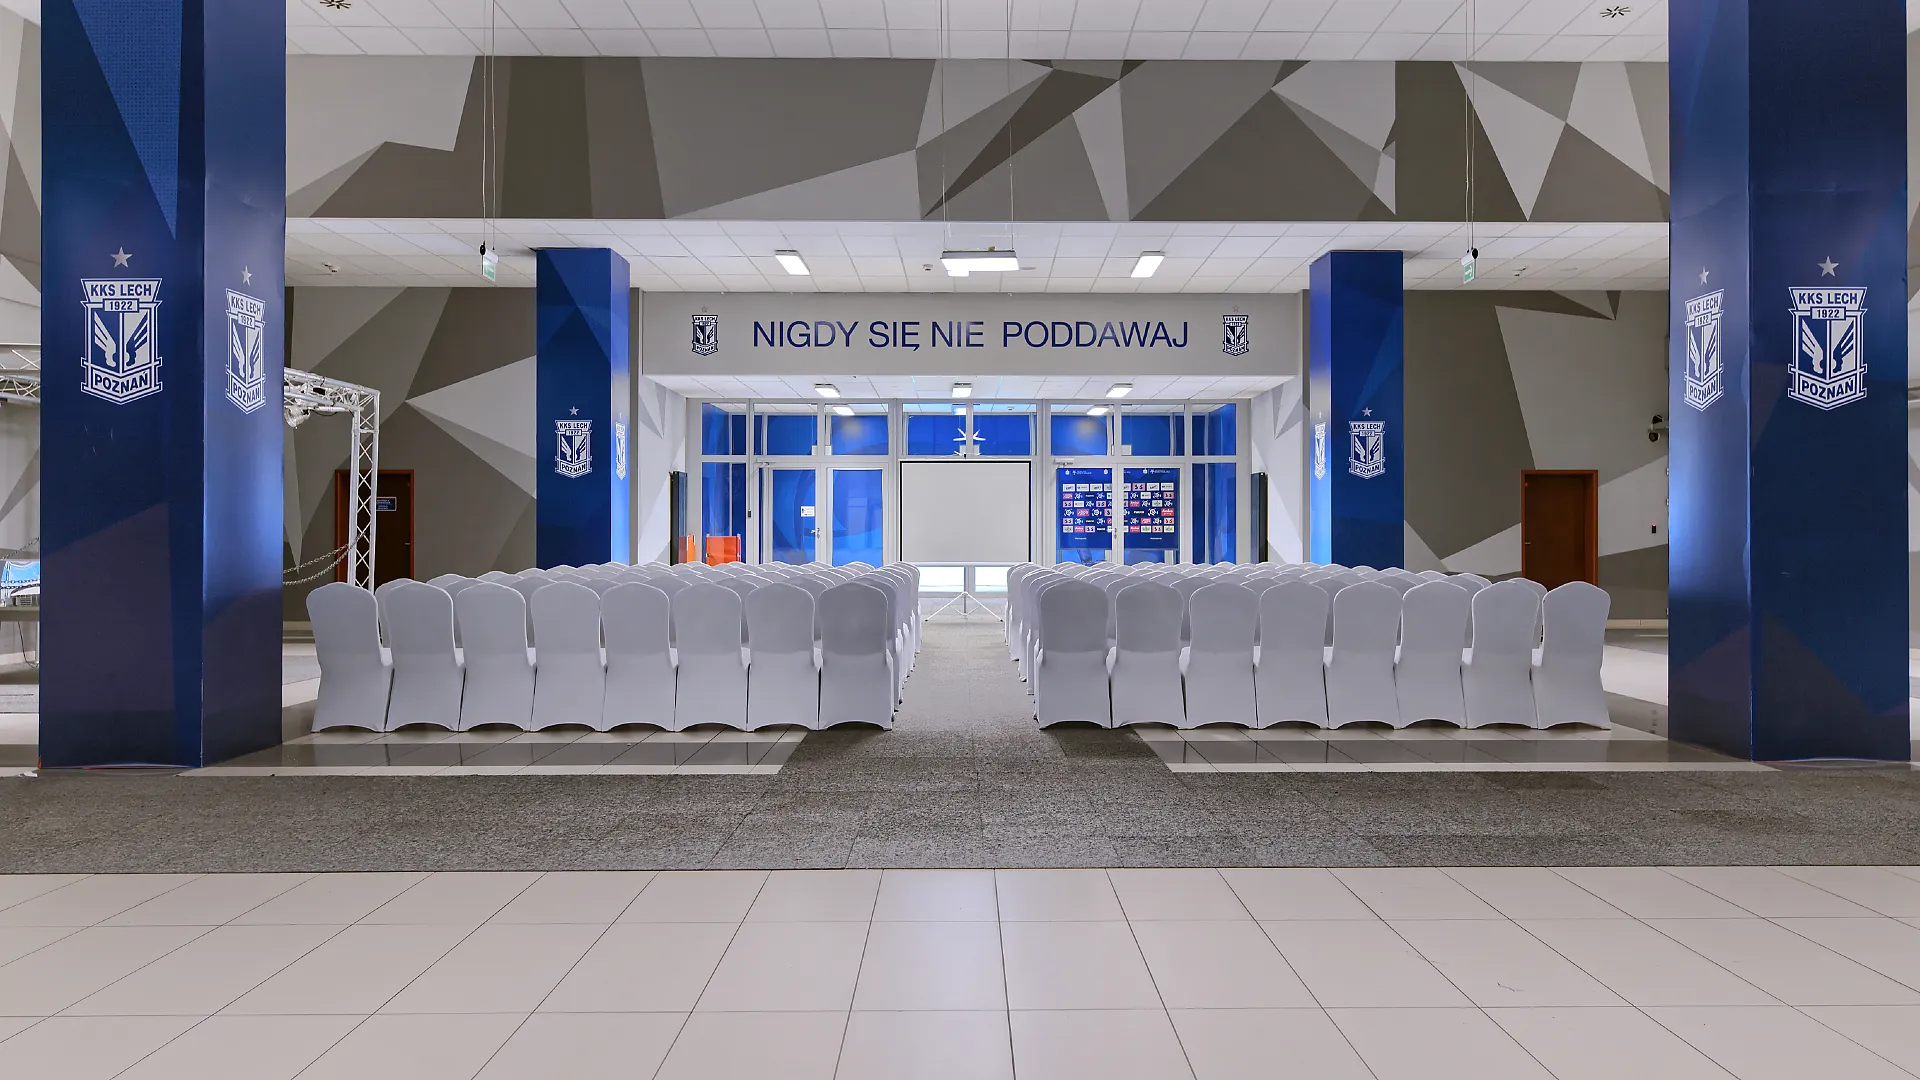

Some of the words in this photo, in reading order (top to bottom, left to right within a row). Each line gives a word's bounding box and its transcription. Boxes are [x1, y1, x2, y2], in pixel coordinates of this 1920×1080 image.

[91, 284, 116, 296] KKS
[120, 284, 152, 296] LECH
[1798, 292, 1823, 304] KKS
[1827, 292, 1857, 304] LECH
[109, 301, 133, 310] 1922
[231, 295, 244, 310] KKS
[246, 300, 261, 316] LECH
[1689, 300, 1700, 316] KKS
[1702, 296, 1719, 312] LECH
[1817, 309, 1840, 318] 1922
[241, 315, 253, 326] 1922
[1697, 315, 1709, 326] 1922
[753, 321, 859, 348] NIGDY
[868, 321, 920, 351] SIĘ
[931, 321, 984, 347] NIE
[1003, 320, 1188, 348] PODDAWAJ
[94, 371, 148, 394] POZNAŃ
[1801, 377, 1854, 400] POZNAŃ
